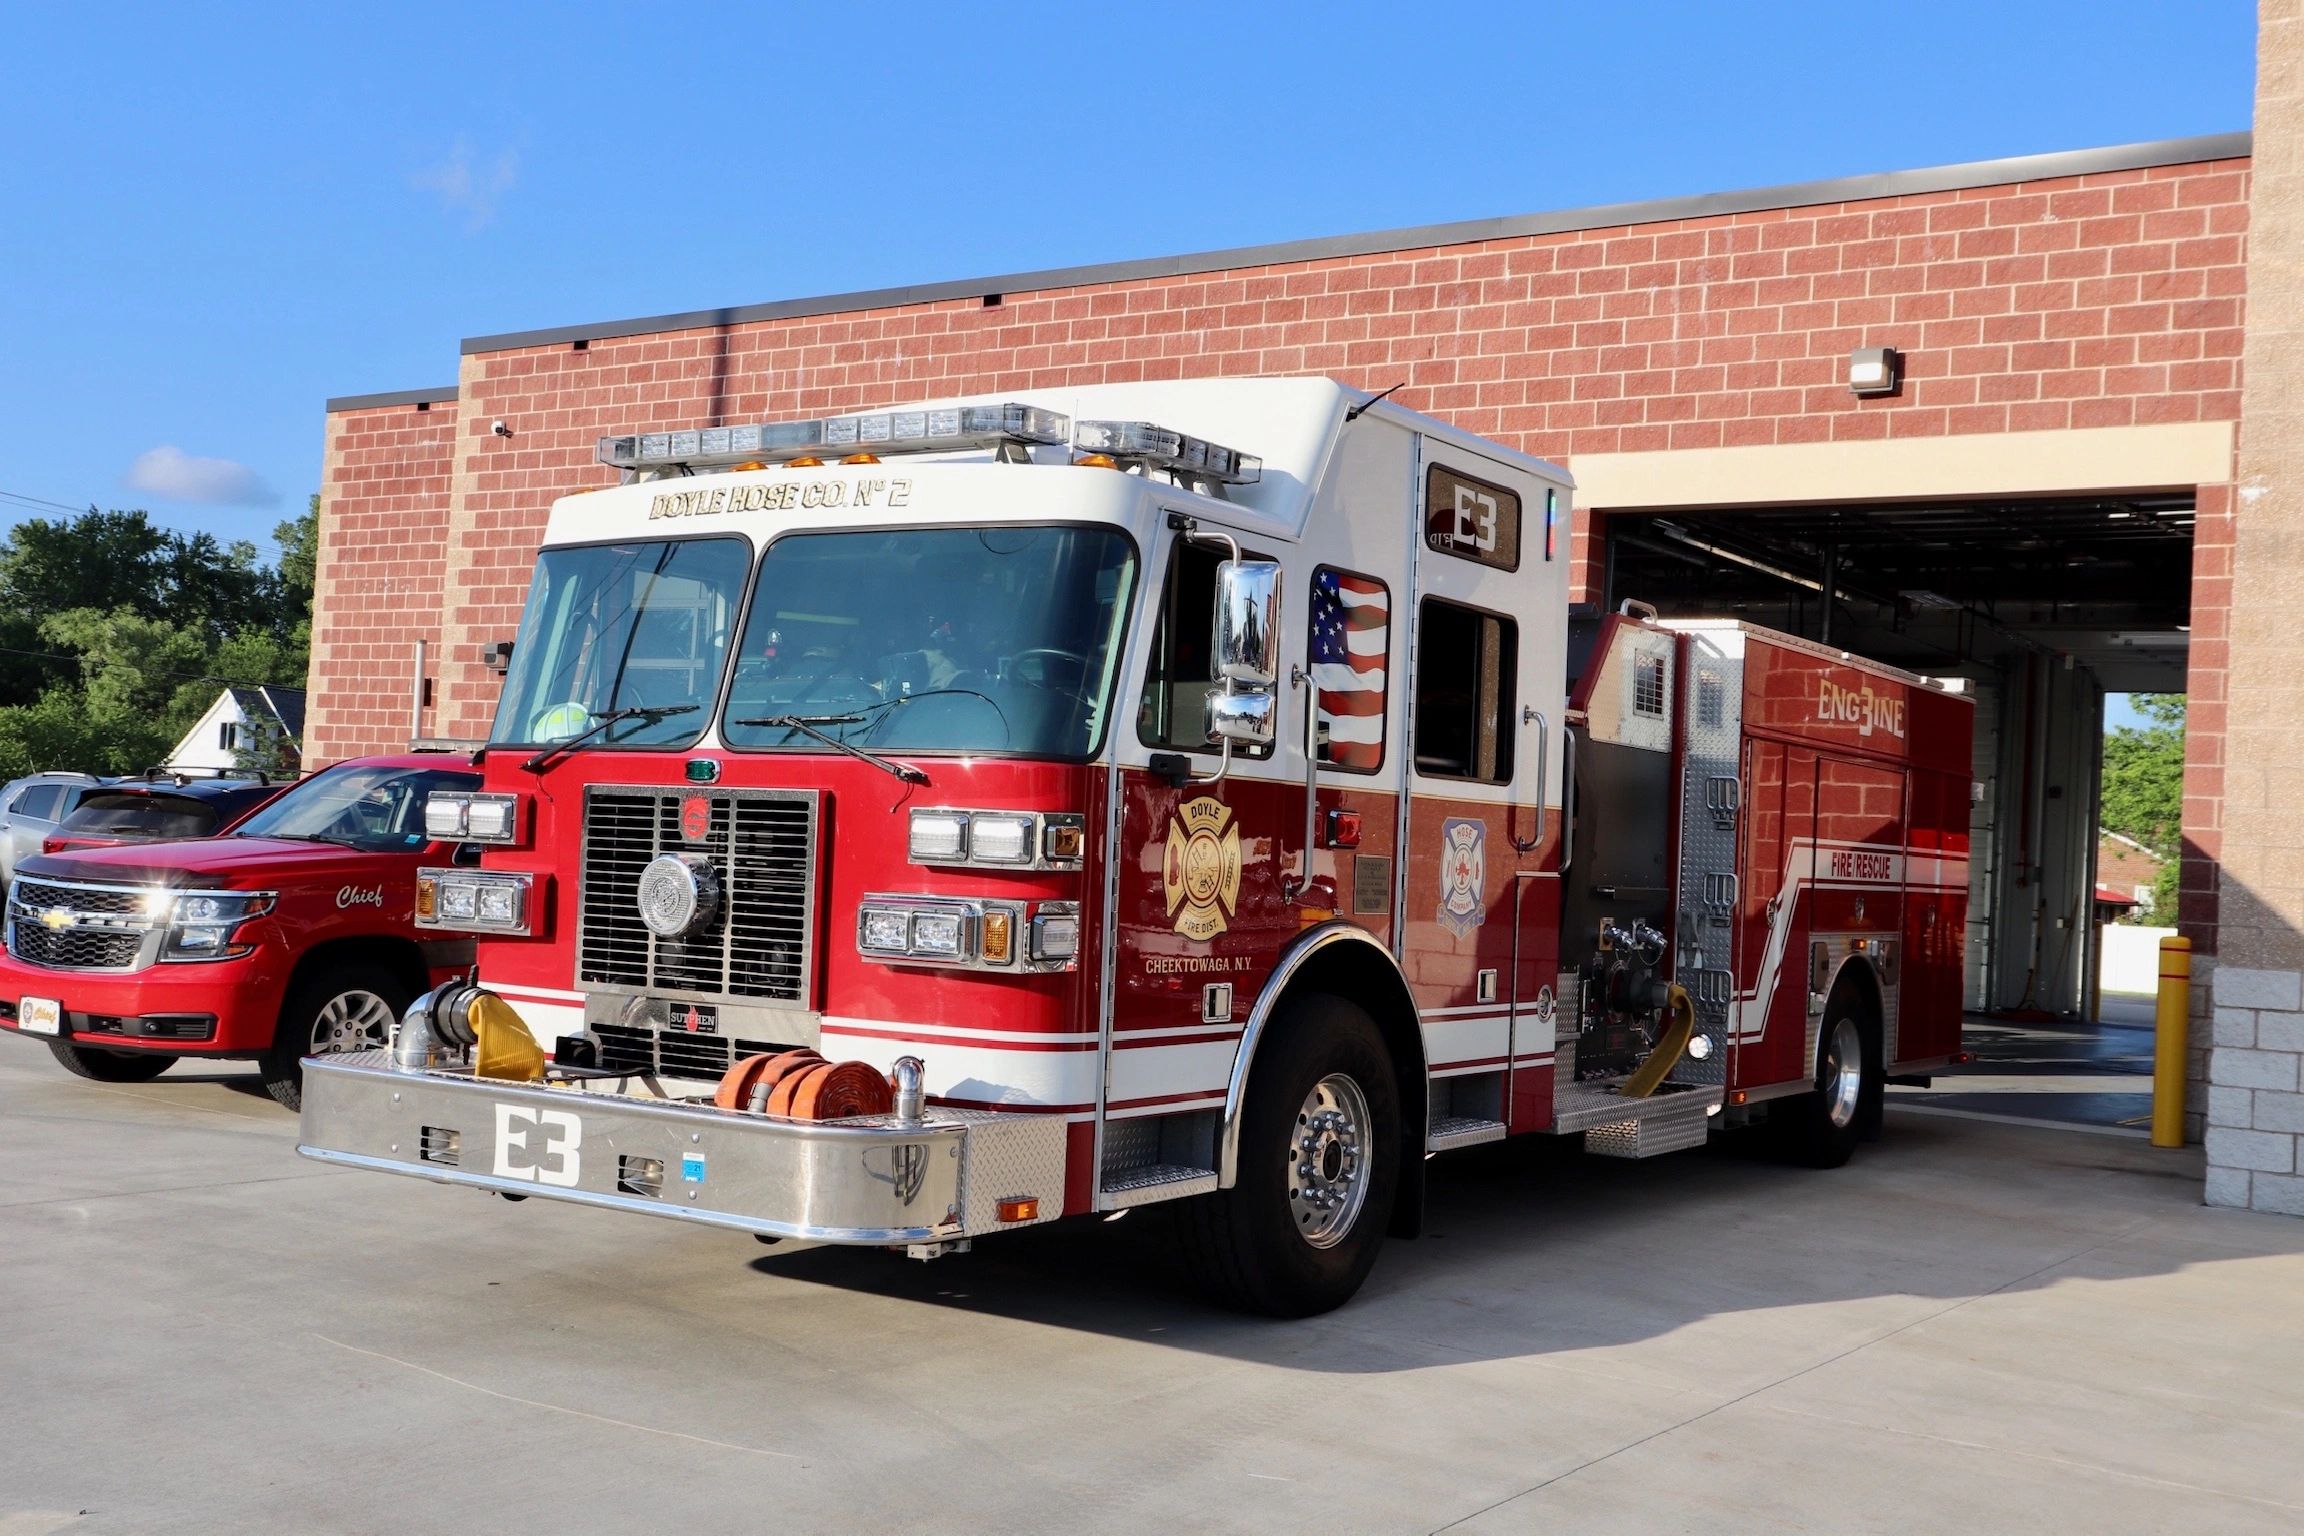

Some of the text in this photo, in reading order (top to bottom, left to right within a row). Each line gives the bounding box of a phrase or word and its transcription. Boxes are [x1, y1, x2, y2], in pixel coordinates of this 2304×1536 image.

[649, 489, 726, 520] DOYLE
[727, 482, 800, 513] HOSE
[888, 479, 912, 507] 2
[1453, 484, 1497, 552] E3
[1191, 803, 1220, 820] DOYLE
[1456, 828, 1472, 839] HOSE
[1831, 852, 1891, 880] FIRE/RESCUE
[336, 884, 383, 908] Chief
[1235, 956, 1252, 971] N.Y.
[493, 1103, 582, 1188] E3
